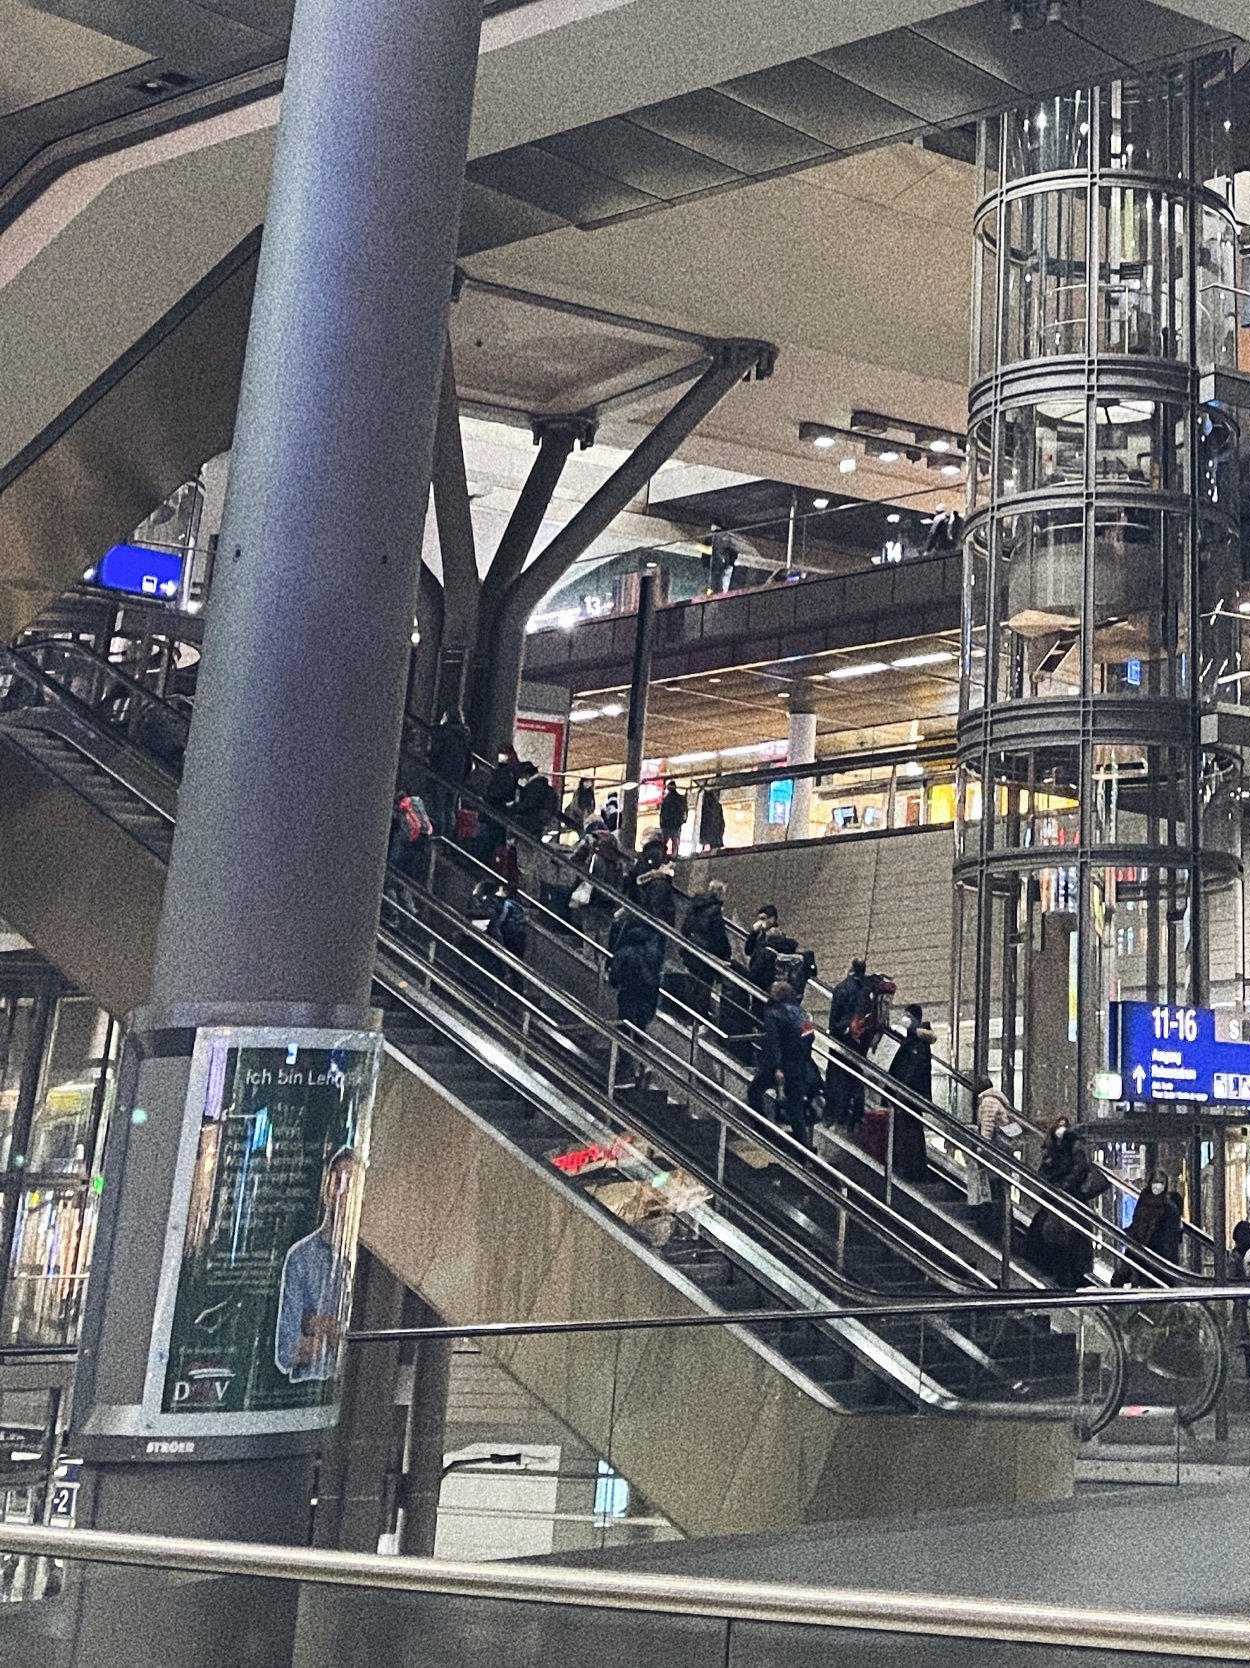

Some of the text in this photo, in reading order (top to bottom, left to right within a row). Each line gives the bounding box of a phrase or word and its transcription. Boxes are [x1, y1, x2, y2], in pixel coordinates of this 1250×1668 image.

[1152, 1006, 1198, 1041] 11-16
[245, 1068, 271, 1085] Ich
[278, 1068, 303, 1085] bin
